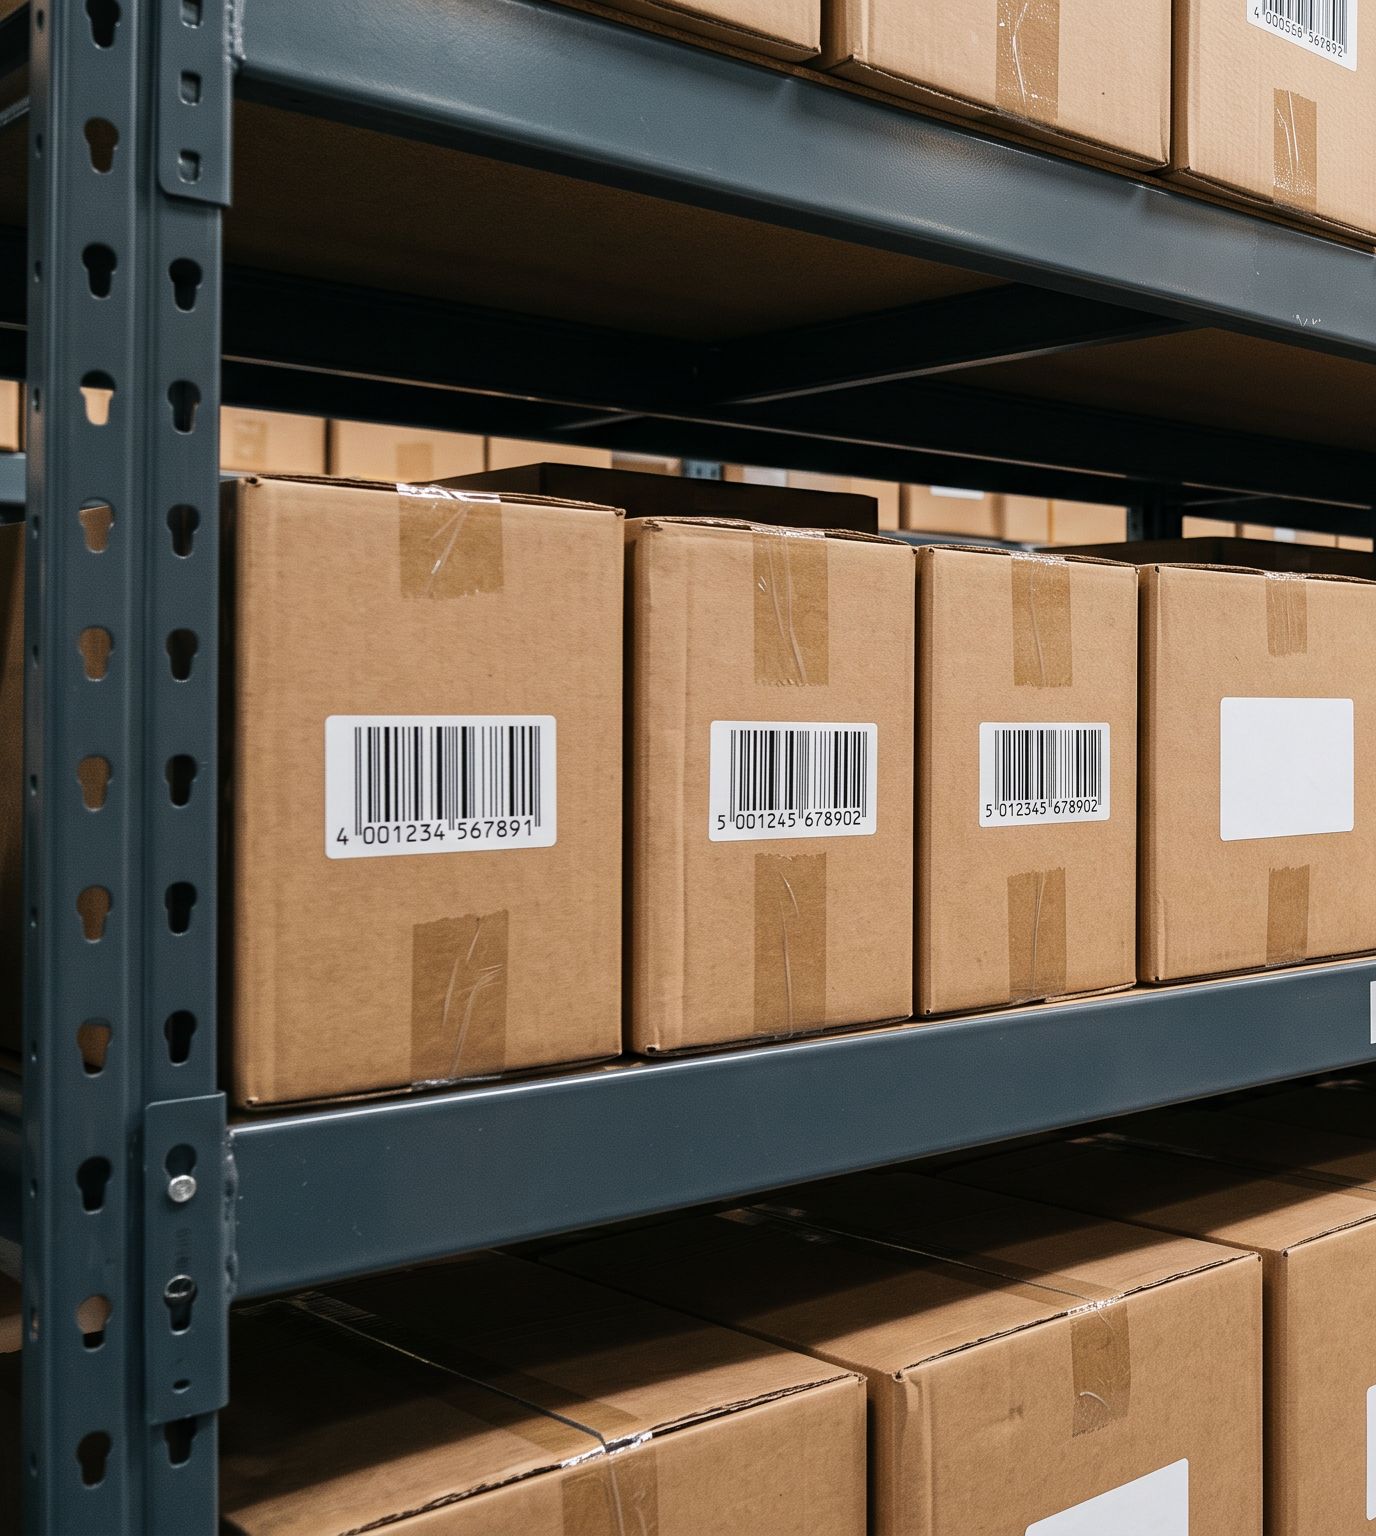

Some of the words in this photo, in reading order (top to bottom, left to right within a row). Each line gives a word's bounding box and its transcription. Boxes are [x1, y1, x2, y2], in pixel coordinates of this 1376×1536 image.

[1254, 7, 1259, 19] 4
[985, 804, 992, 818] 5
[999, 802, 1047, 817] 012345
[1053, 799, 1098, 815] 678902
[717, 814, 726, 831] 5
[736, 812, 796, 830] 001245
[804, 811, 861, 827] 678902
[336, 827, 349, 846] 4
[363, 823, 446, 845] 001234
[457, 819, 532, 840] 567891
